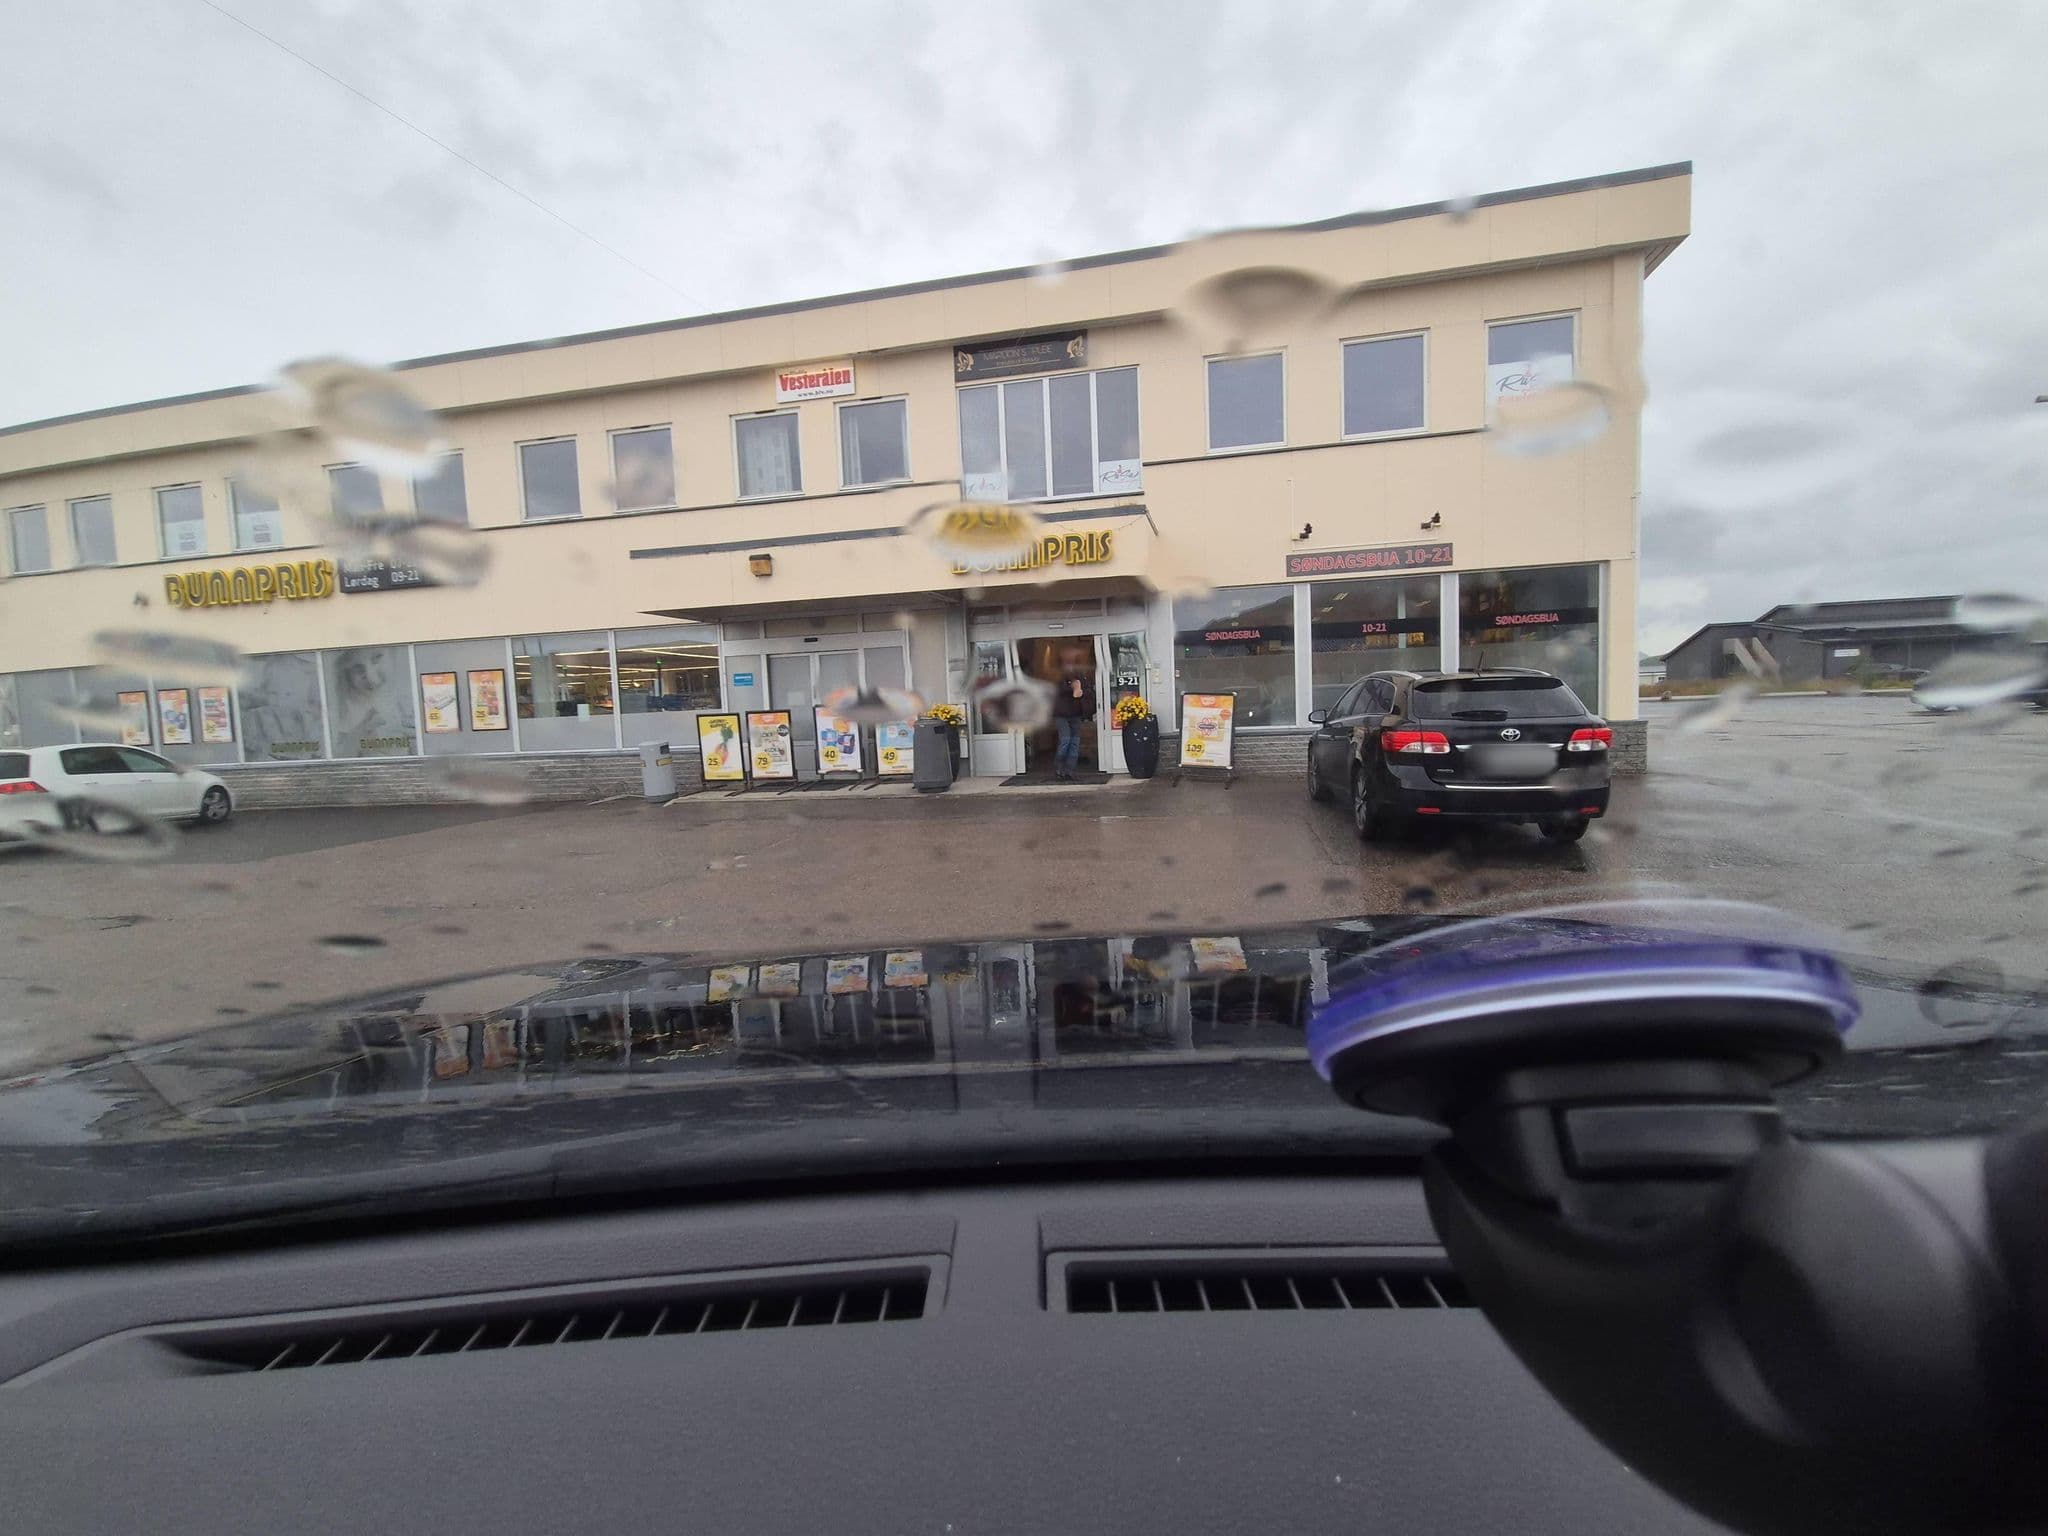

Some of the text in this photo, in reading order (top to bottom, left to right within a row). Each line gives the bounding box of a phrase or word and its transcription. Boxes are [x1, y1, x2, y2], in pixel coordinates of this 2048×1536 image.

[779, 366, 851, 392] Vesterålen
[951, 528, 1114, 575] NPRIS
[1290, 546, 1452, 573] SØNDAGSBUA 10-21
[391, 569, 420, 582] 09-21
[163, 558, 335, 609] BUNNPRIS
[1495, 613, 1559, 626] SØNDAGSBUA
[1361, 623, 1387, 633] 10-21
[1205, 629, 1261, 641] SØNDAGSBUA
[1118, 677, 1138, 686] 9-21
[824, 750, 836, 759] 40
[883, 752, 895, 761] 49
[708, 757, 719, 766] 25
[757, 757, 768, 766] 79
